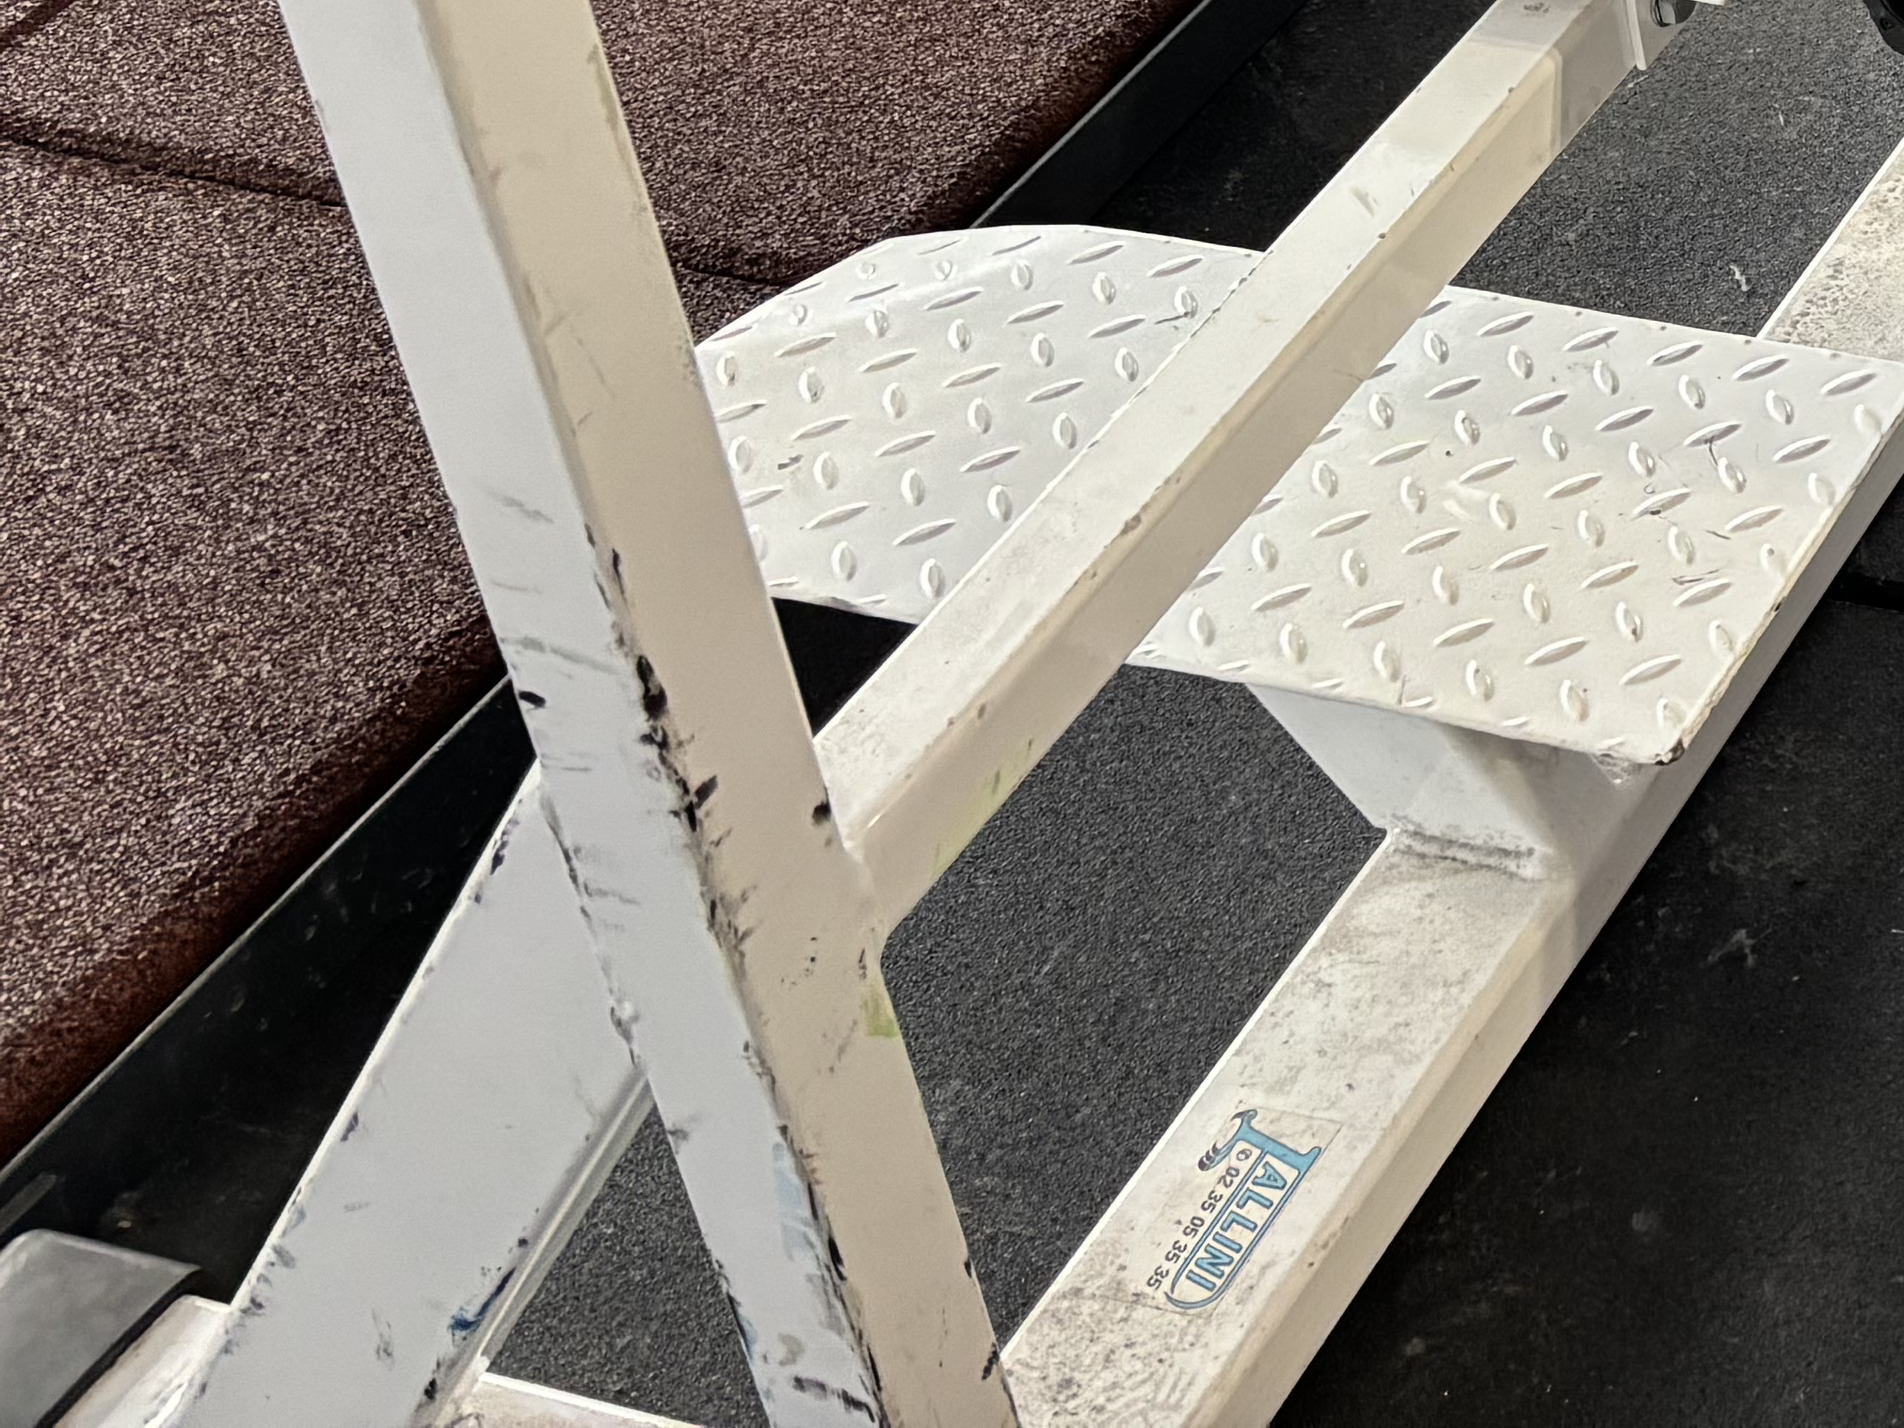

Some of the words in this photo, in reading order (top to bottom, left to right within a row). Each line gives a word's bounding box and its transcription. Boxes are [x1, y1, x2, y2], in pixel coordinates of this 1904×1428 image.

[1218, 1166, 1241, 1189] 02
[1200, 1189, 1224, 1214] 35
[1182, 1215, 1206, 1239] 05
[1164, 1239, 1188, 1265] 35
[1146, 1265, 1170, 1291] 35
